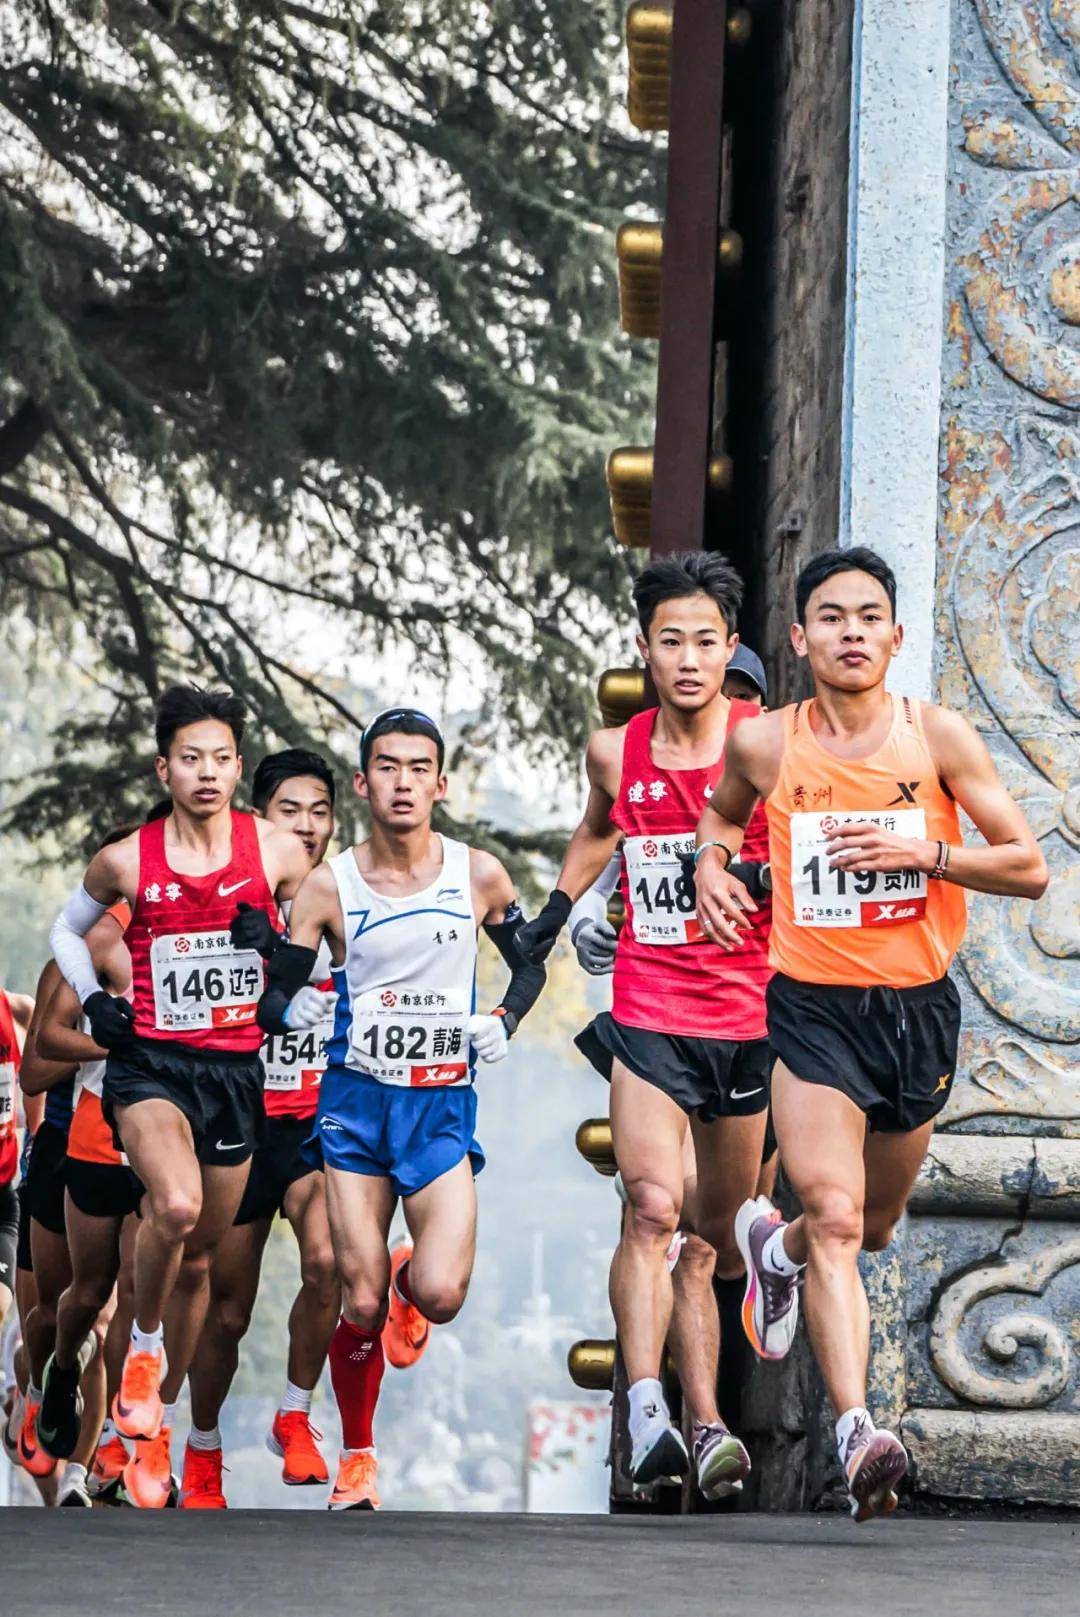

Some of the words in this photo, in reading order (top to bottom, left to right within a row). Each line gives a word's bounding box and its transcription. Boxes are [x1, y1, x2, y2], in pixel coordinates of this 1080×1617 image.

[803, 856, 877, 895] 119
[636, 877, 697, 914] 148
[163, 967, 225, 1004] 146
[229, 967, 259, 998] 辽宁
[400, 993, 447, 1006] 南京银行
[261, 1033, 317, 1066] 154
[363, 1024, 428, 1060] 182
[432, 1026, 462, 1057] 青海
